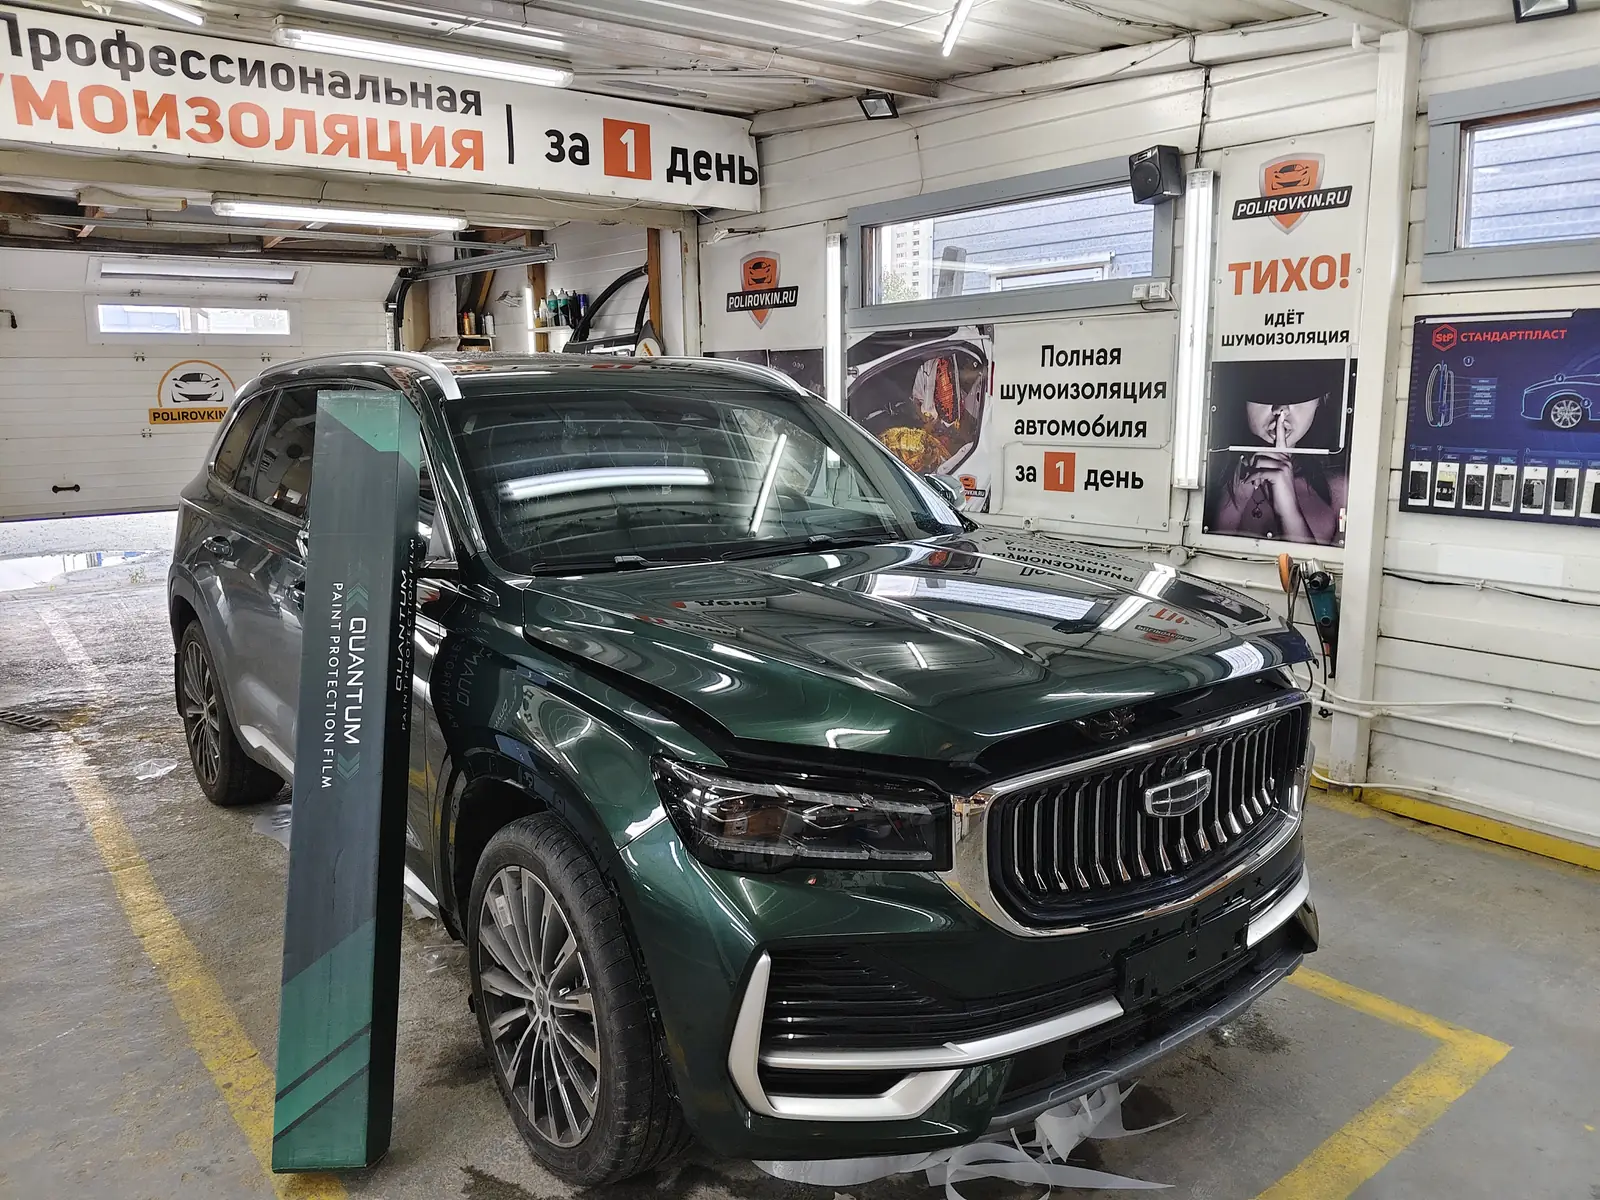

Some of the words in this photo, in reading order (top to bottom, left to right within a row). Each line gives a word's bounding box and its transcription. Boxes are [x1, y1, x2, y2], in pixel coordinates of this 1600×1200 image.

[0, 11, 482, 116] Профессиональная
[0, 73, 484, 171] МОИЗОЛЯЦИЯ
[545, 129, 590, 166] за
[619, 128, 636, 173] 1
[666, 146, 758, 186] день
[1236, 190, 1349, 217] POLIROVKIN.RU
[1228, 253, 1351, 296] ТИХО!
[728, 290, 796, 309] POLIROVKIN.RU
[1264, 309, 1305, 327] ИДЁТ
[1221, 330, 1350, 347] ШУМОИЗОЛЯЦИЯ
[1435, 333, 1454, 343] StP
[1460, 329, 1568, 343] СТАНДАРТПЛАСТ
[1041, 344, 1122, 367] Полная
[1000, 381, 1167, 405] шумоизоляция
[1014, 414, 1147, 438] автомобиля
[1015, 465, 1037, 482] за
[1055, 461, 1065, 485] 1
[1084, 469, 1144, 491] день
[329, 582, 343, 630] PAINT
[395, 569, 408, 692] QUANTUM
[404, 579, 413, 679] PROTECTION
[324, 636, 341, 743] PROTECTION
[343, 617, 366, 744] QUANTUM
[321, 749, 334, 788] FILM
